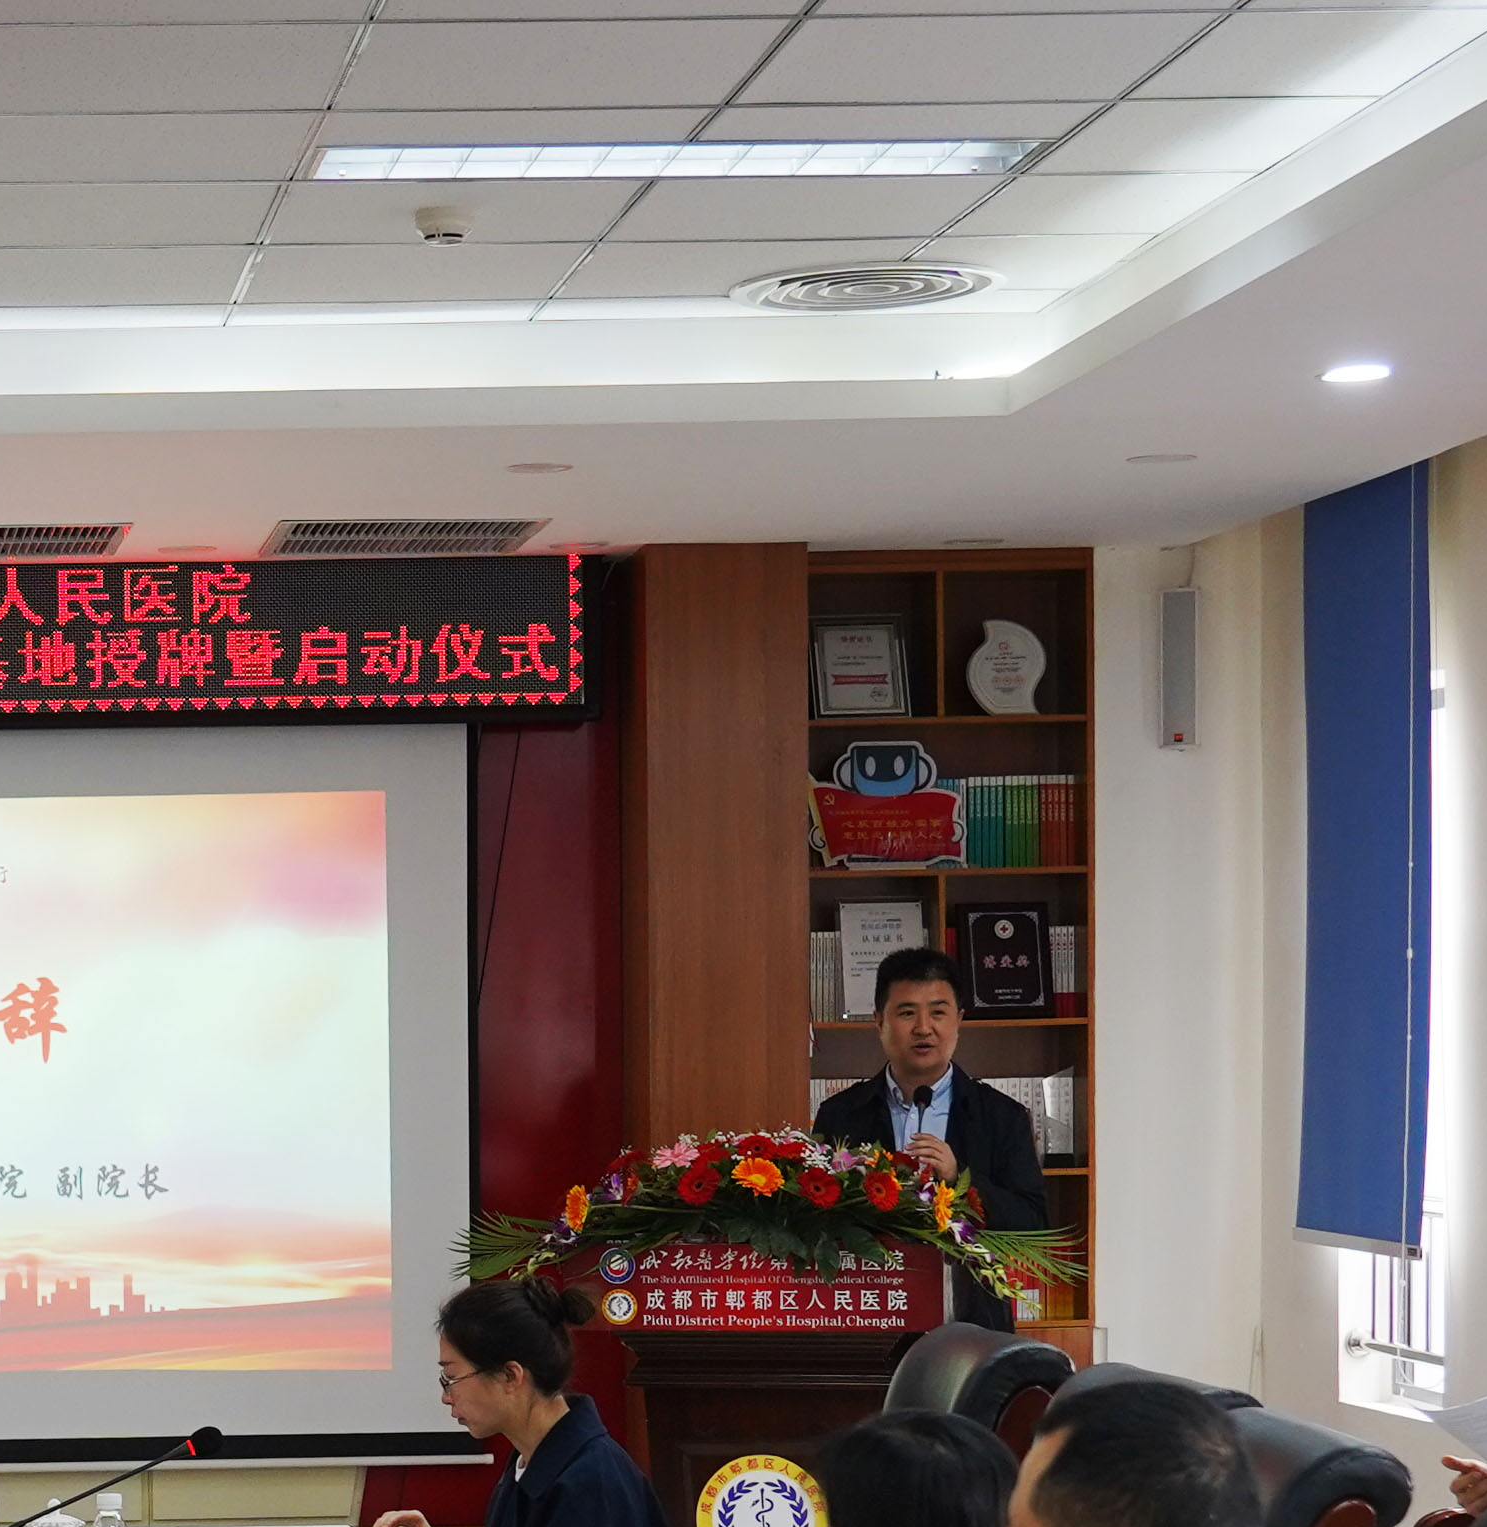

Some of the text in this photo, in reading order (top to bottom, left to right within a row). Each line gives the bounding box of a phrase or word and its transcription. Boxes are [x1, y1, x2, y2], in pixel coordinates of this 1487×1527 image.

[56, 1165, 169, 1201] 副院长
[640, 1275, 904, 1286] The 3rd Affiliated Hospital Of Chengdu edical College
[645, 1289, 908, 1311] 成都市郫都区人民医院
[643, 1314, 672, 1326] Pidu
[676, 1314, 725, 1326] District
[728, 1315, 783, 1328] People's
